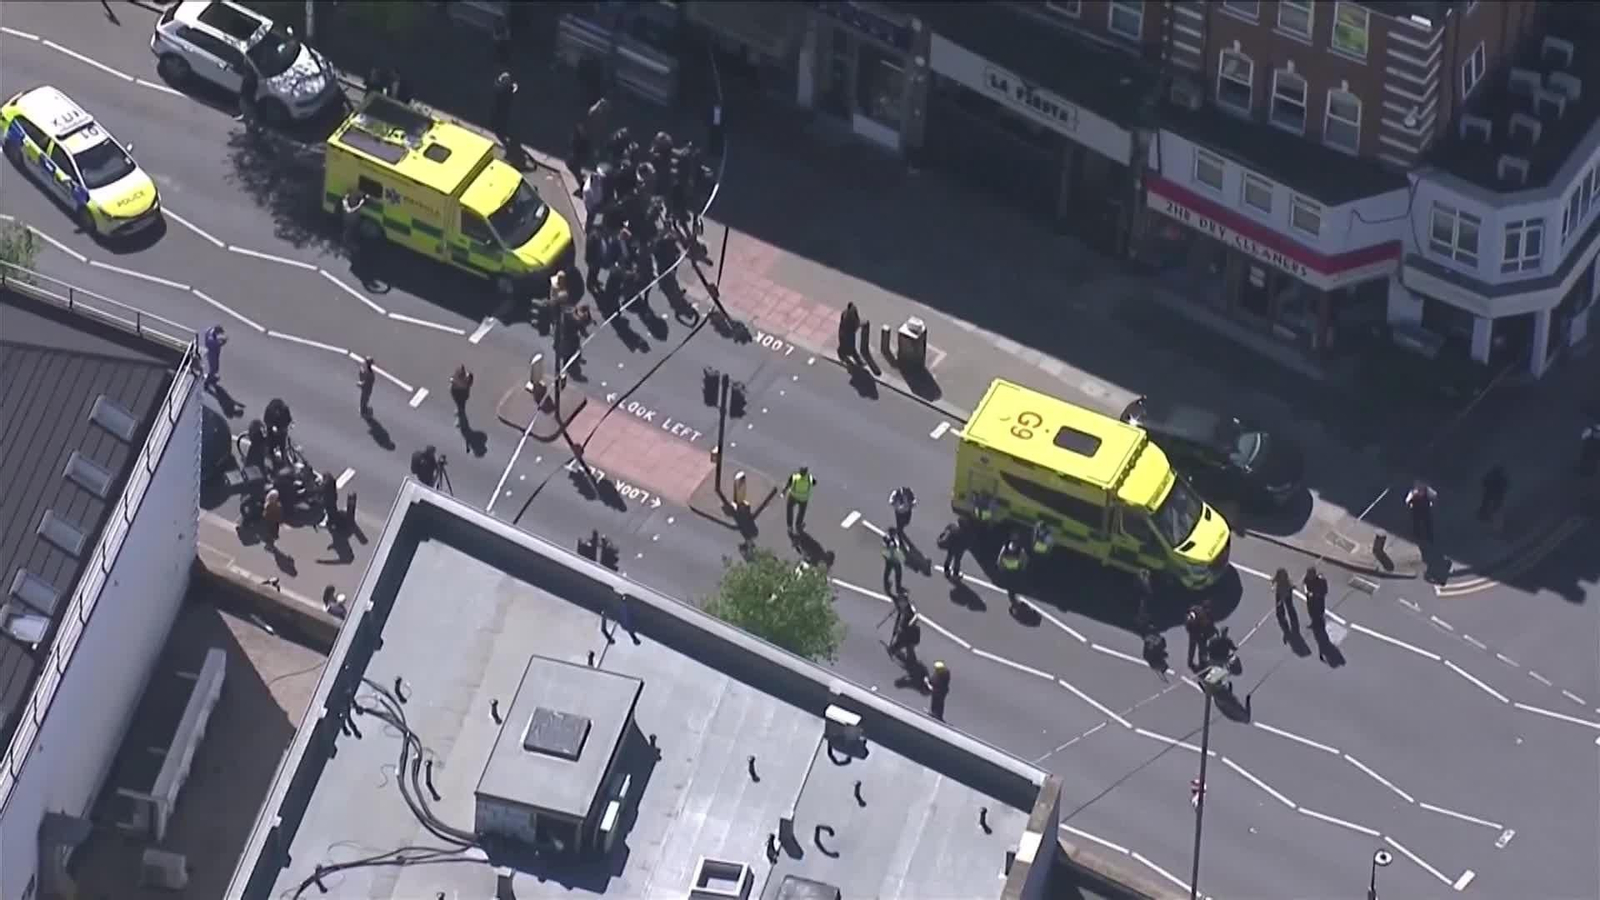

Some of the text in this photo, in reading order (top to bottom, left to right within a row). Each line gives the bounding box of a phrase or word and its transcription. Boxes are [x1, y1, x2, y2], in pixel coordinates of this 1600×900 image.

[117, 190, 145, 207] POLICE
[1199, 218, 1226, 241] DRY
[755, 331, 795, 356] LOOK
[618, 398, 702, 442] LOOK LEFT
[1010, 410, 1043, 441] G9
[615, 479, 650, 504] LOOK
